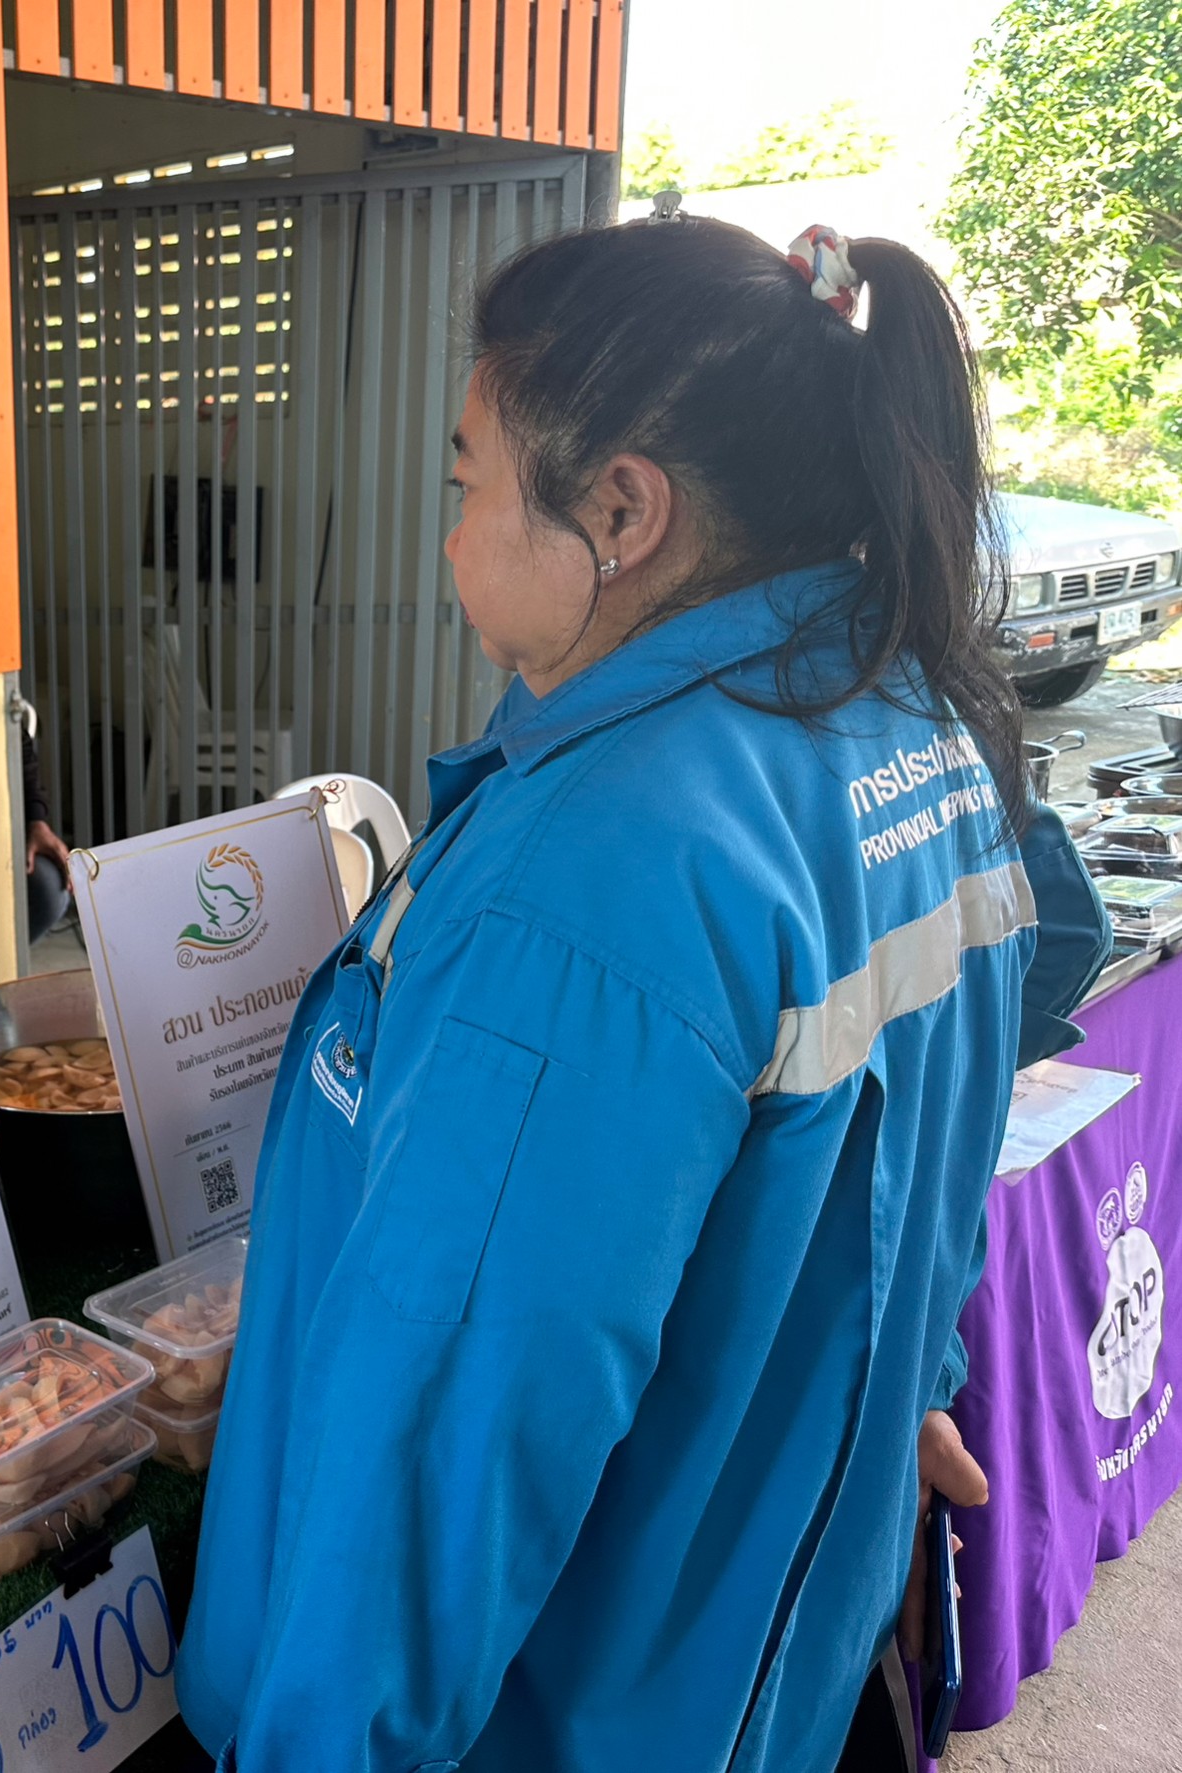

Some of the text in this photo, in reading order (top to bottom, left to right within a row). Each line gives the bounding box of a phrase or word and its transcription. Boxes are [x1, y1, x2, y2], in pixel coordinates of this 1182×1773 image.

[177, 920, 270, 969] @NAKHONNAYOK
[162, 1011, 204, 1045] สวน
[24, 1600, 54, 1630] บาท
[17, 1707, 58, 1750] กล่อง
[51, 1574, 179, 1753] 100
